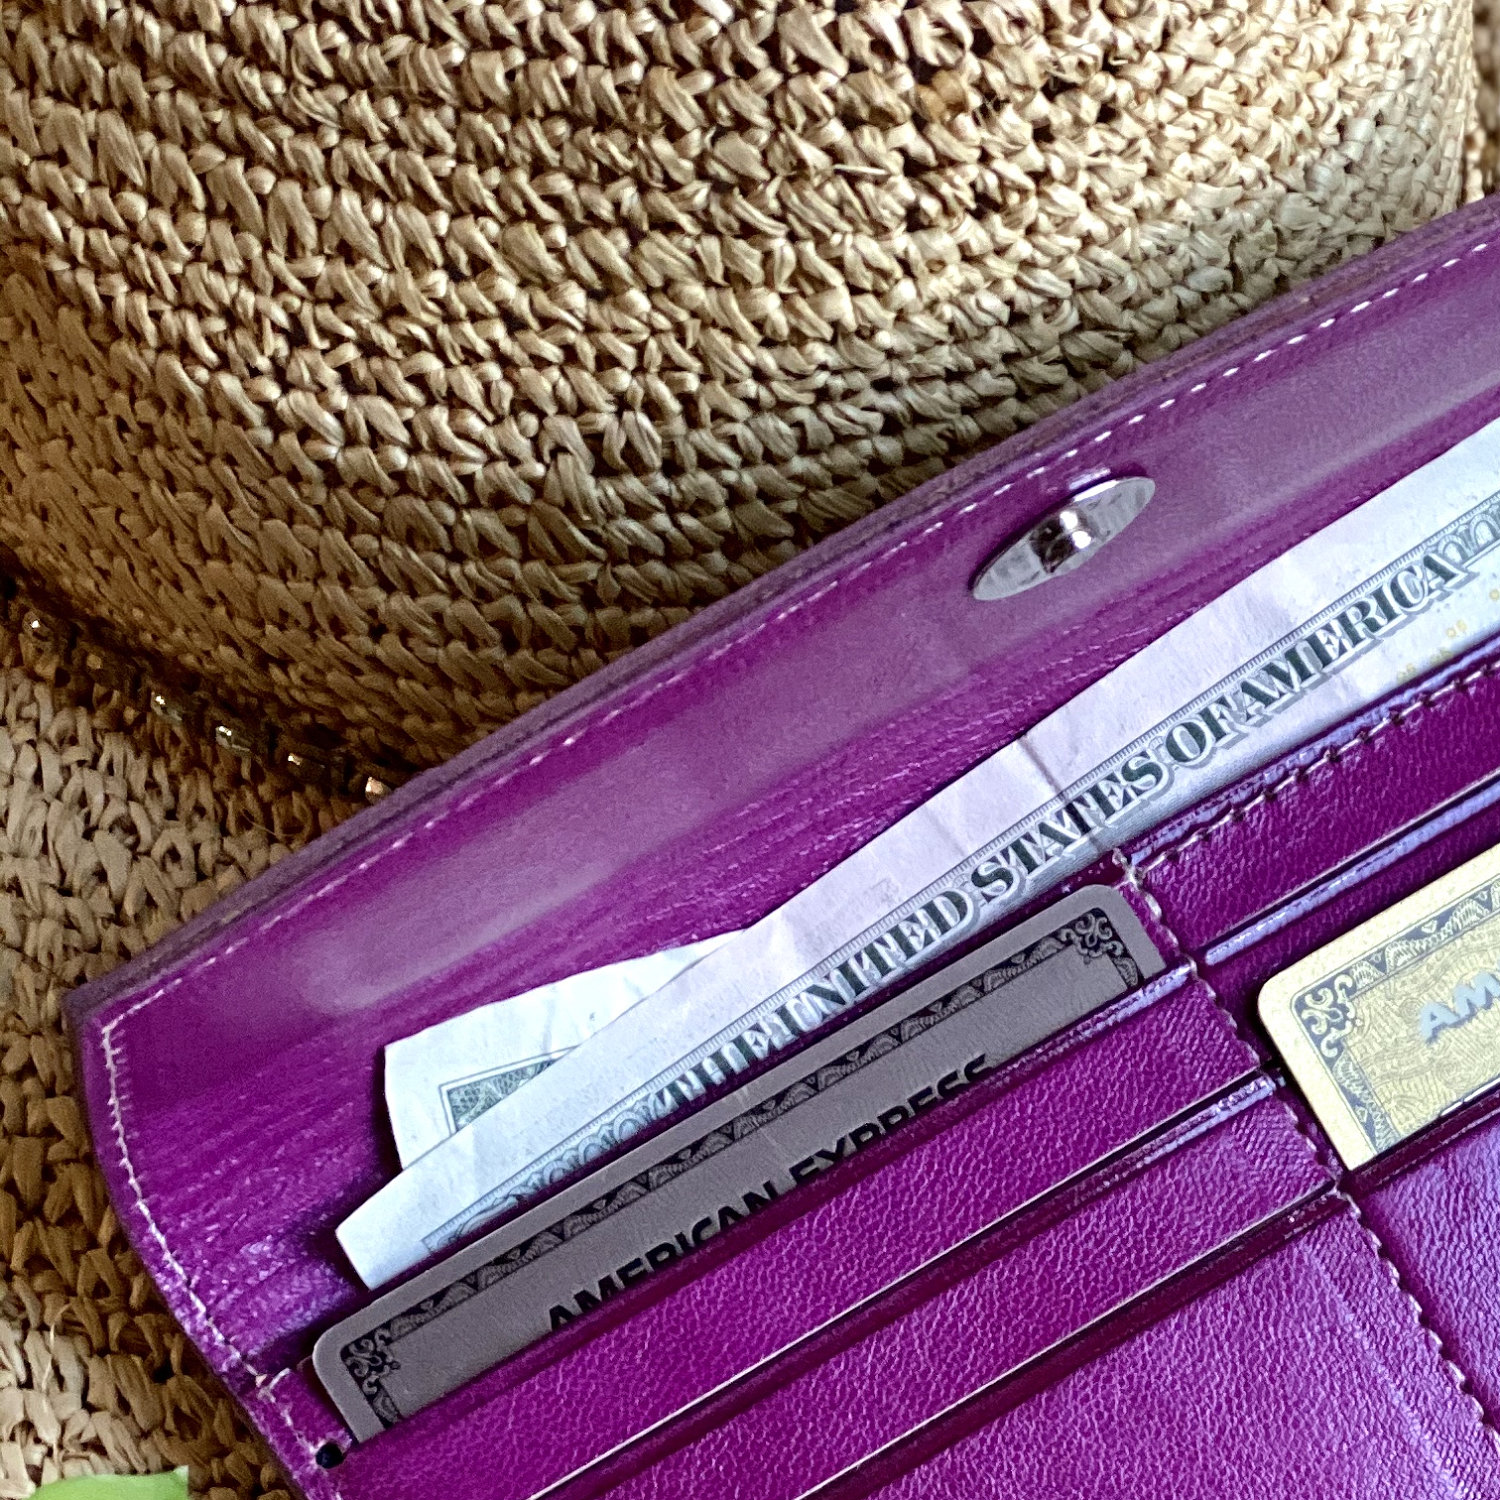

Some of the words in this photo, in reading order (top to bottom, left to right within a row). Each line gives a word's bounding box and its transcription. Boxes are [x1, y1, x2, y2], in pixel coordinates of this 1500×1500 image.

[776, 889, 978, 1050] UNITED
[970, 750, 1172, 901] STATES
[1162, 694, 1242, 768] OF
[1236, 550, 1472, 726] AMERICA
